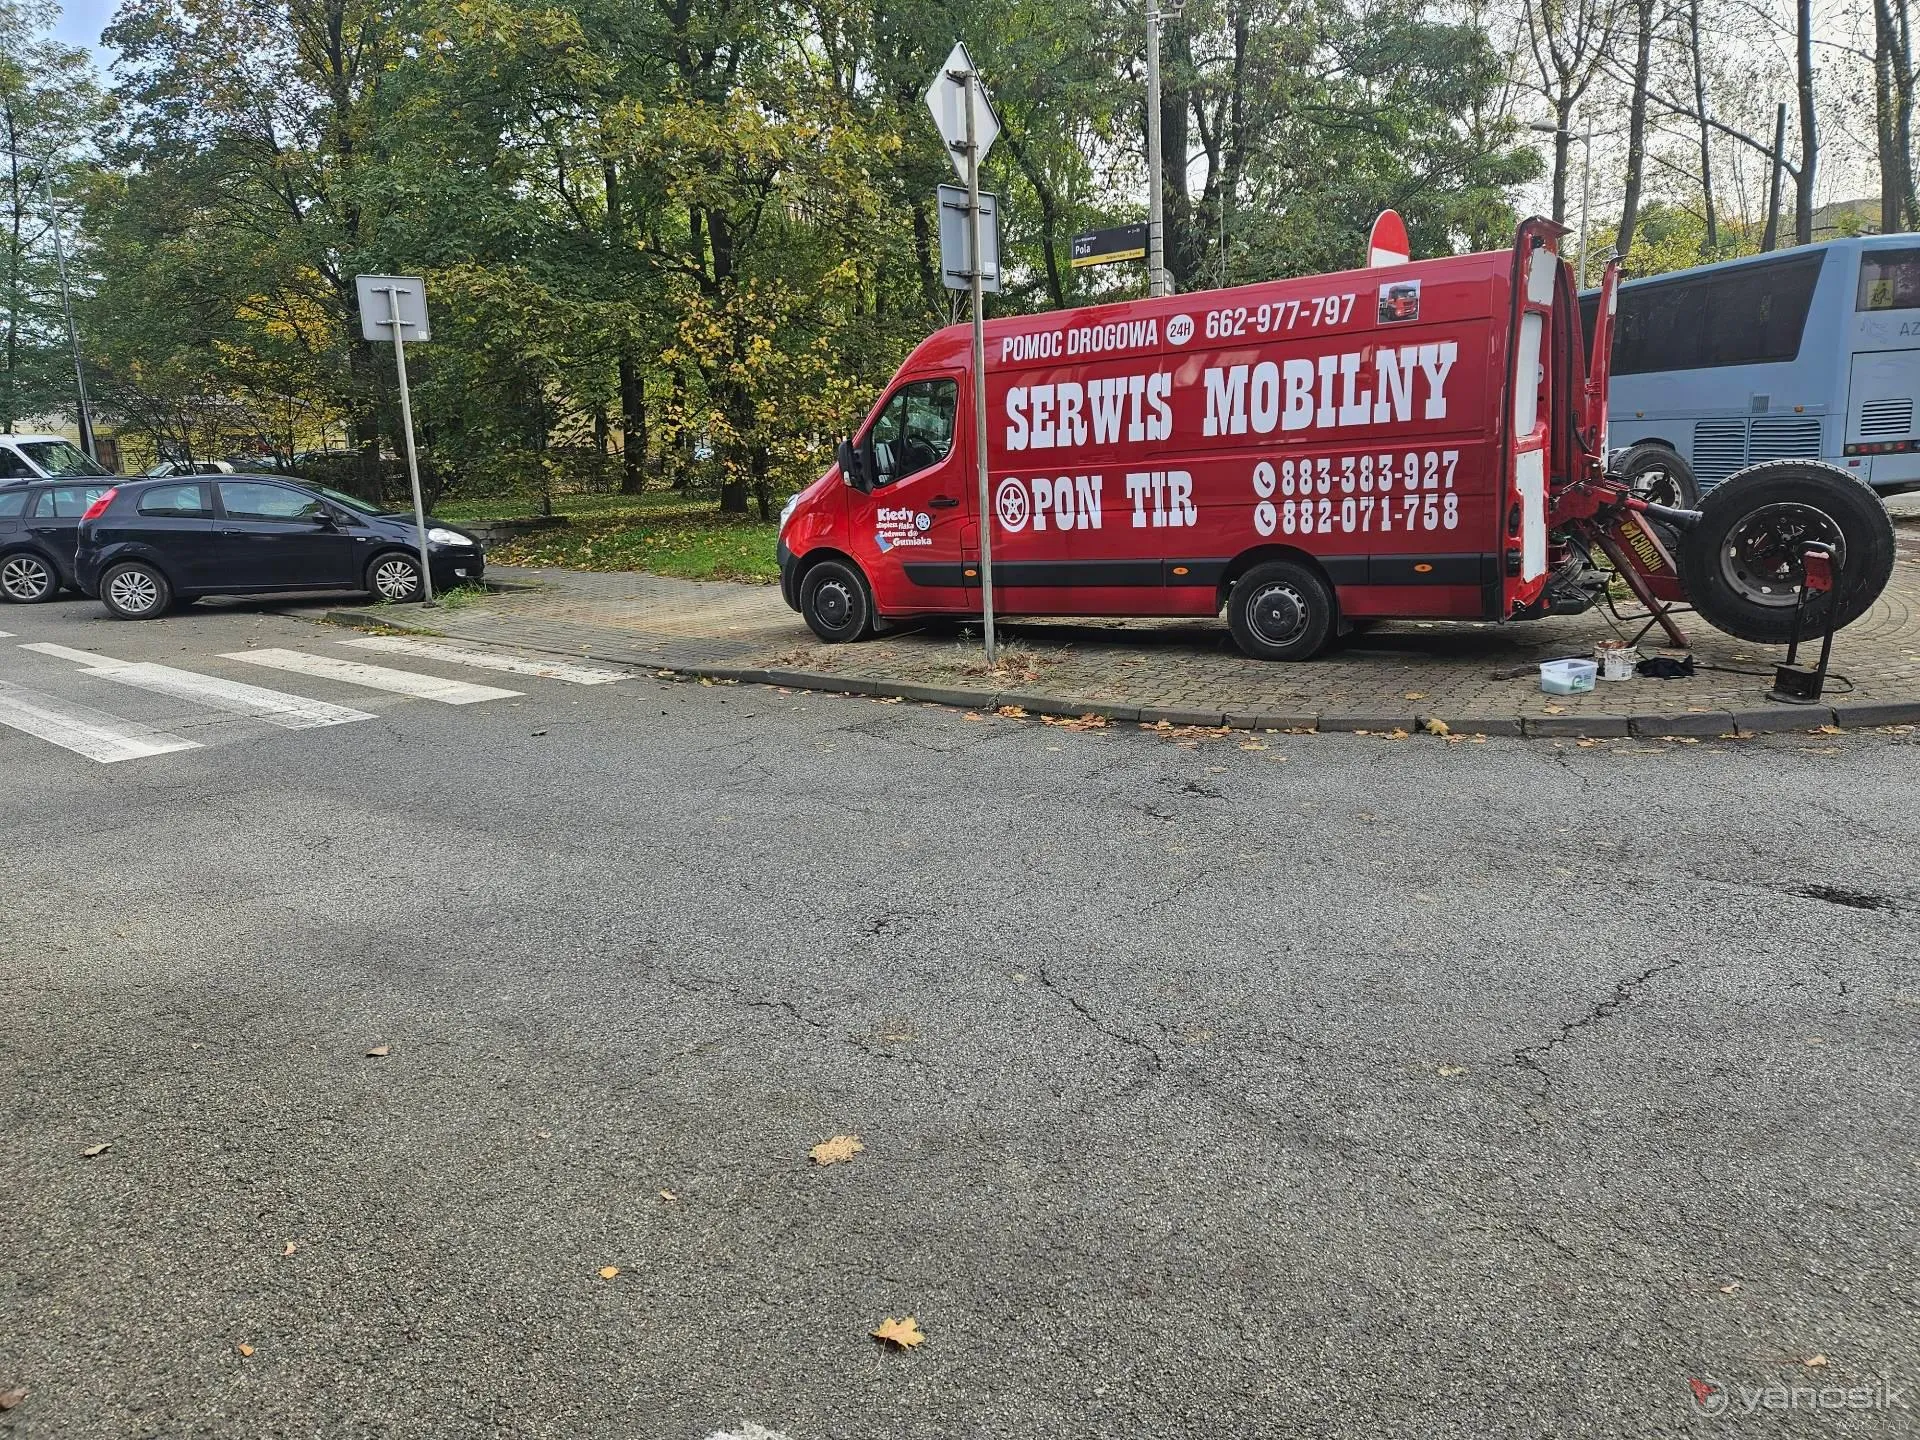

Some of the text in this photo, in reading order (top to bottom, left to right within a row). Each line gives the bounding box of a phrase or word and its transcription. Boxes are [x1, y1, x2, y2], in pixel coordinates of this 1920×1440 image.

[1075, 244, 1091, 255] Pola
[1002, 294, 1356, 362] POMOC DROGOWA 24H 662-977-797
[1006, 342, 1458, 451] SERWIS MOBILNY
[1281, 450, 1459, 496] 883-383-927
[877, 507, 914, 522] Kiedy
[1125, 470, 1198, 528] TIR
[1282, 493, 1459, 534] 882-071-758
[892, 537, 932, 547] Gumiaka
[1630, 533, 1663, 572] CORGHI
